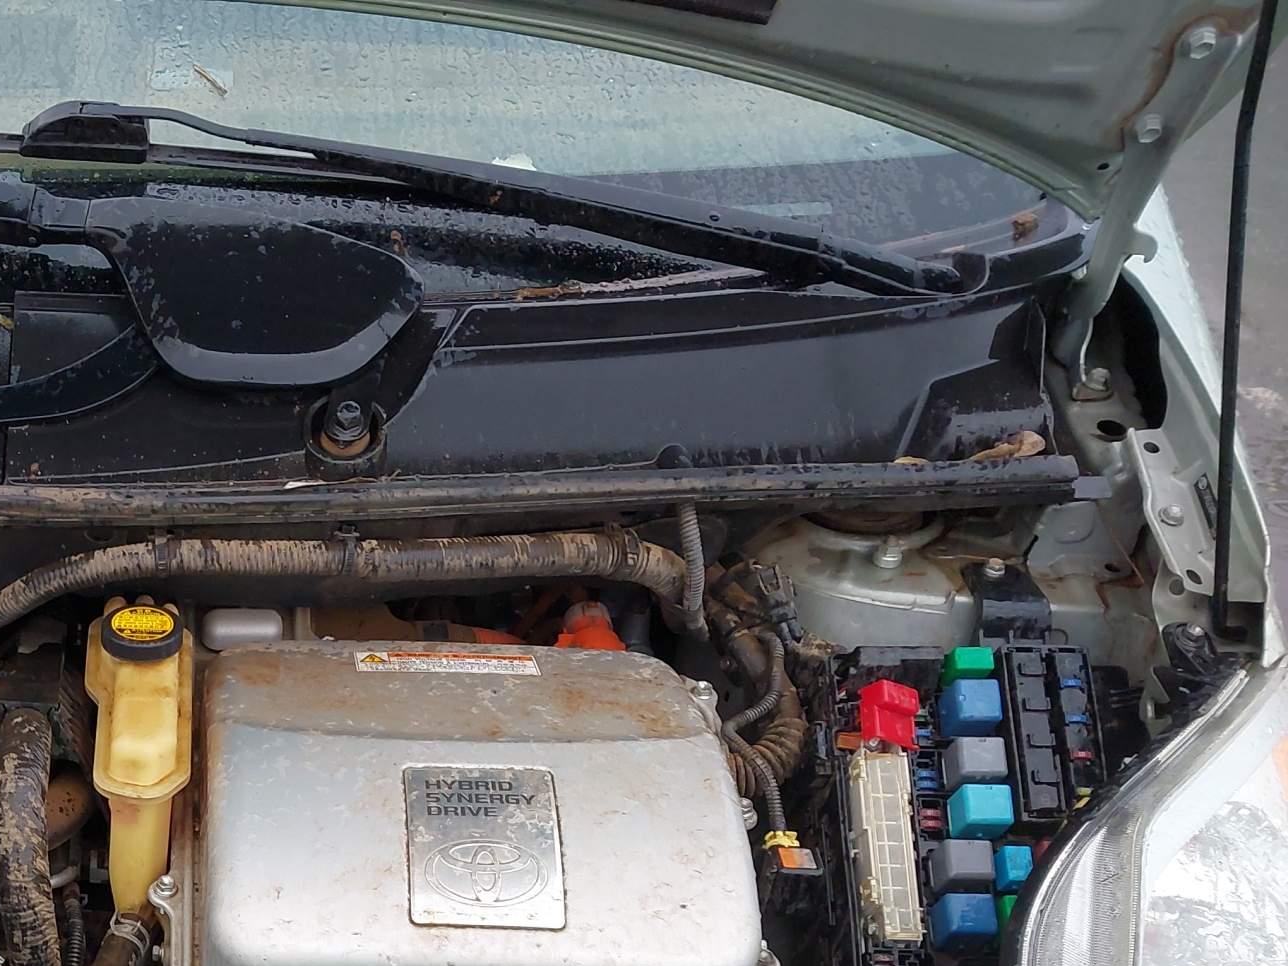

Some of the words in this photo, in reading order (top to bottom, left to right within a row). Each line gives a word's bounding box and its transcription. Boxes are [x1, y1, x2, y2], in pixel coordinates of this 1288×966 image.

[425, 779, 512, 792] HYBRID
[426, 792, 536, 805] SYNERGY
[427, 805, 498, 817] DRIVE
